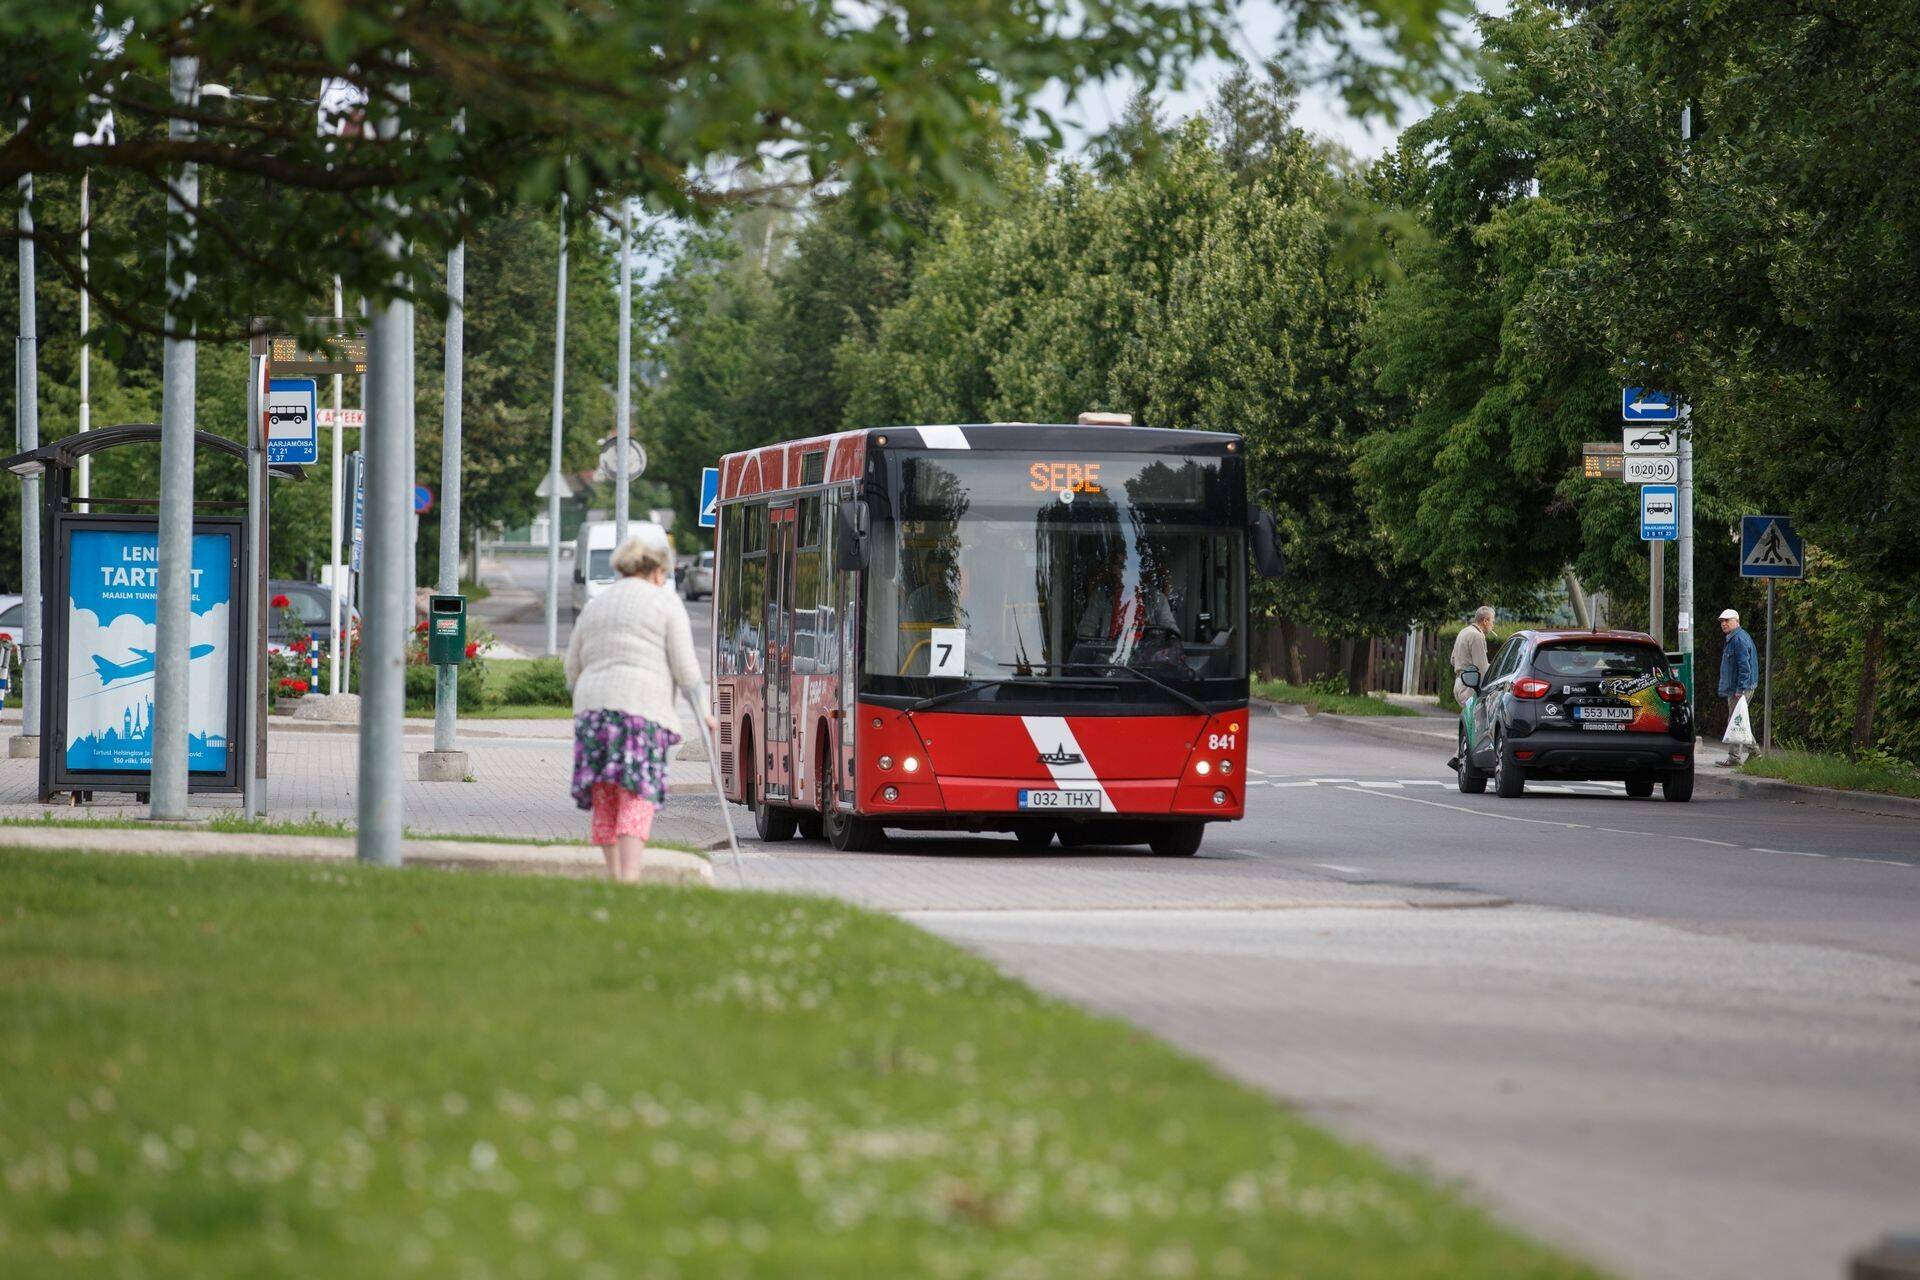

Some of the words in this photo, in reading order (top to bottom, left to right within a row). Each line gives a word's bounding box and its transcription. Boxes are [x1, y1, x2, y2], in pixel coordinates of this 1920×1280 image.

[267, 440, 314, 448] AARJAMÕISA
[1630, 465, 1640, 475] 10
[1642, 465, 1654, 475] 20
[1657, 465, 1670, 475] 50
[1030, 463, 1102, 493] SEBE
[102, 592, 133, 600] MAAILM
[936, 643, 953, 668] 7
[1584, 708, 1603, 718] 553
[1606, 708, 1630, 718] MJM
[1208, 734, 1235, 750] 841
[1033, 793, 1058, 806] 032
[1065, 793, 1093, 806] THX
